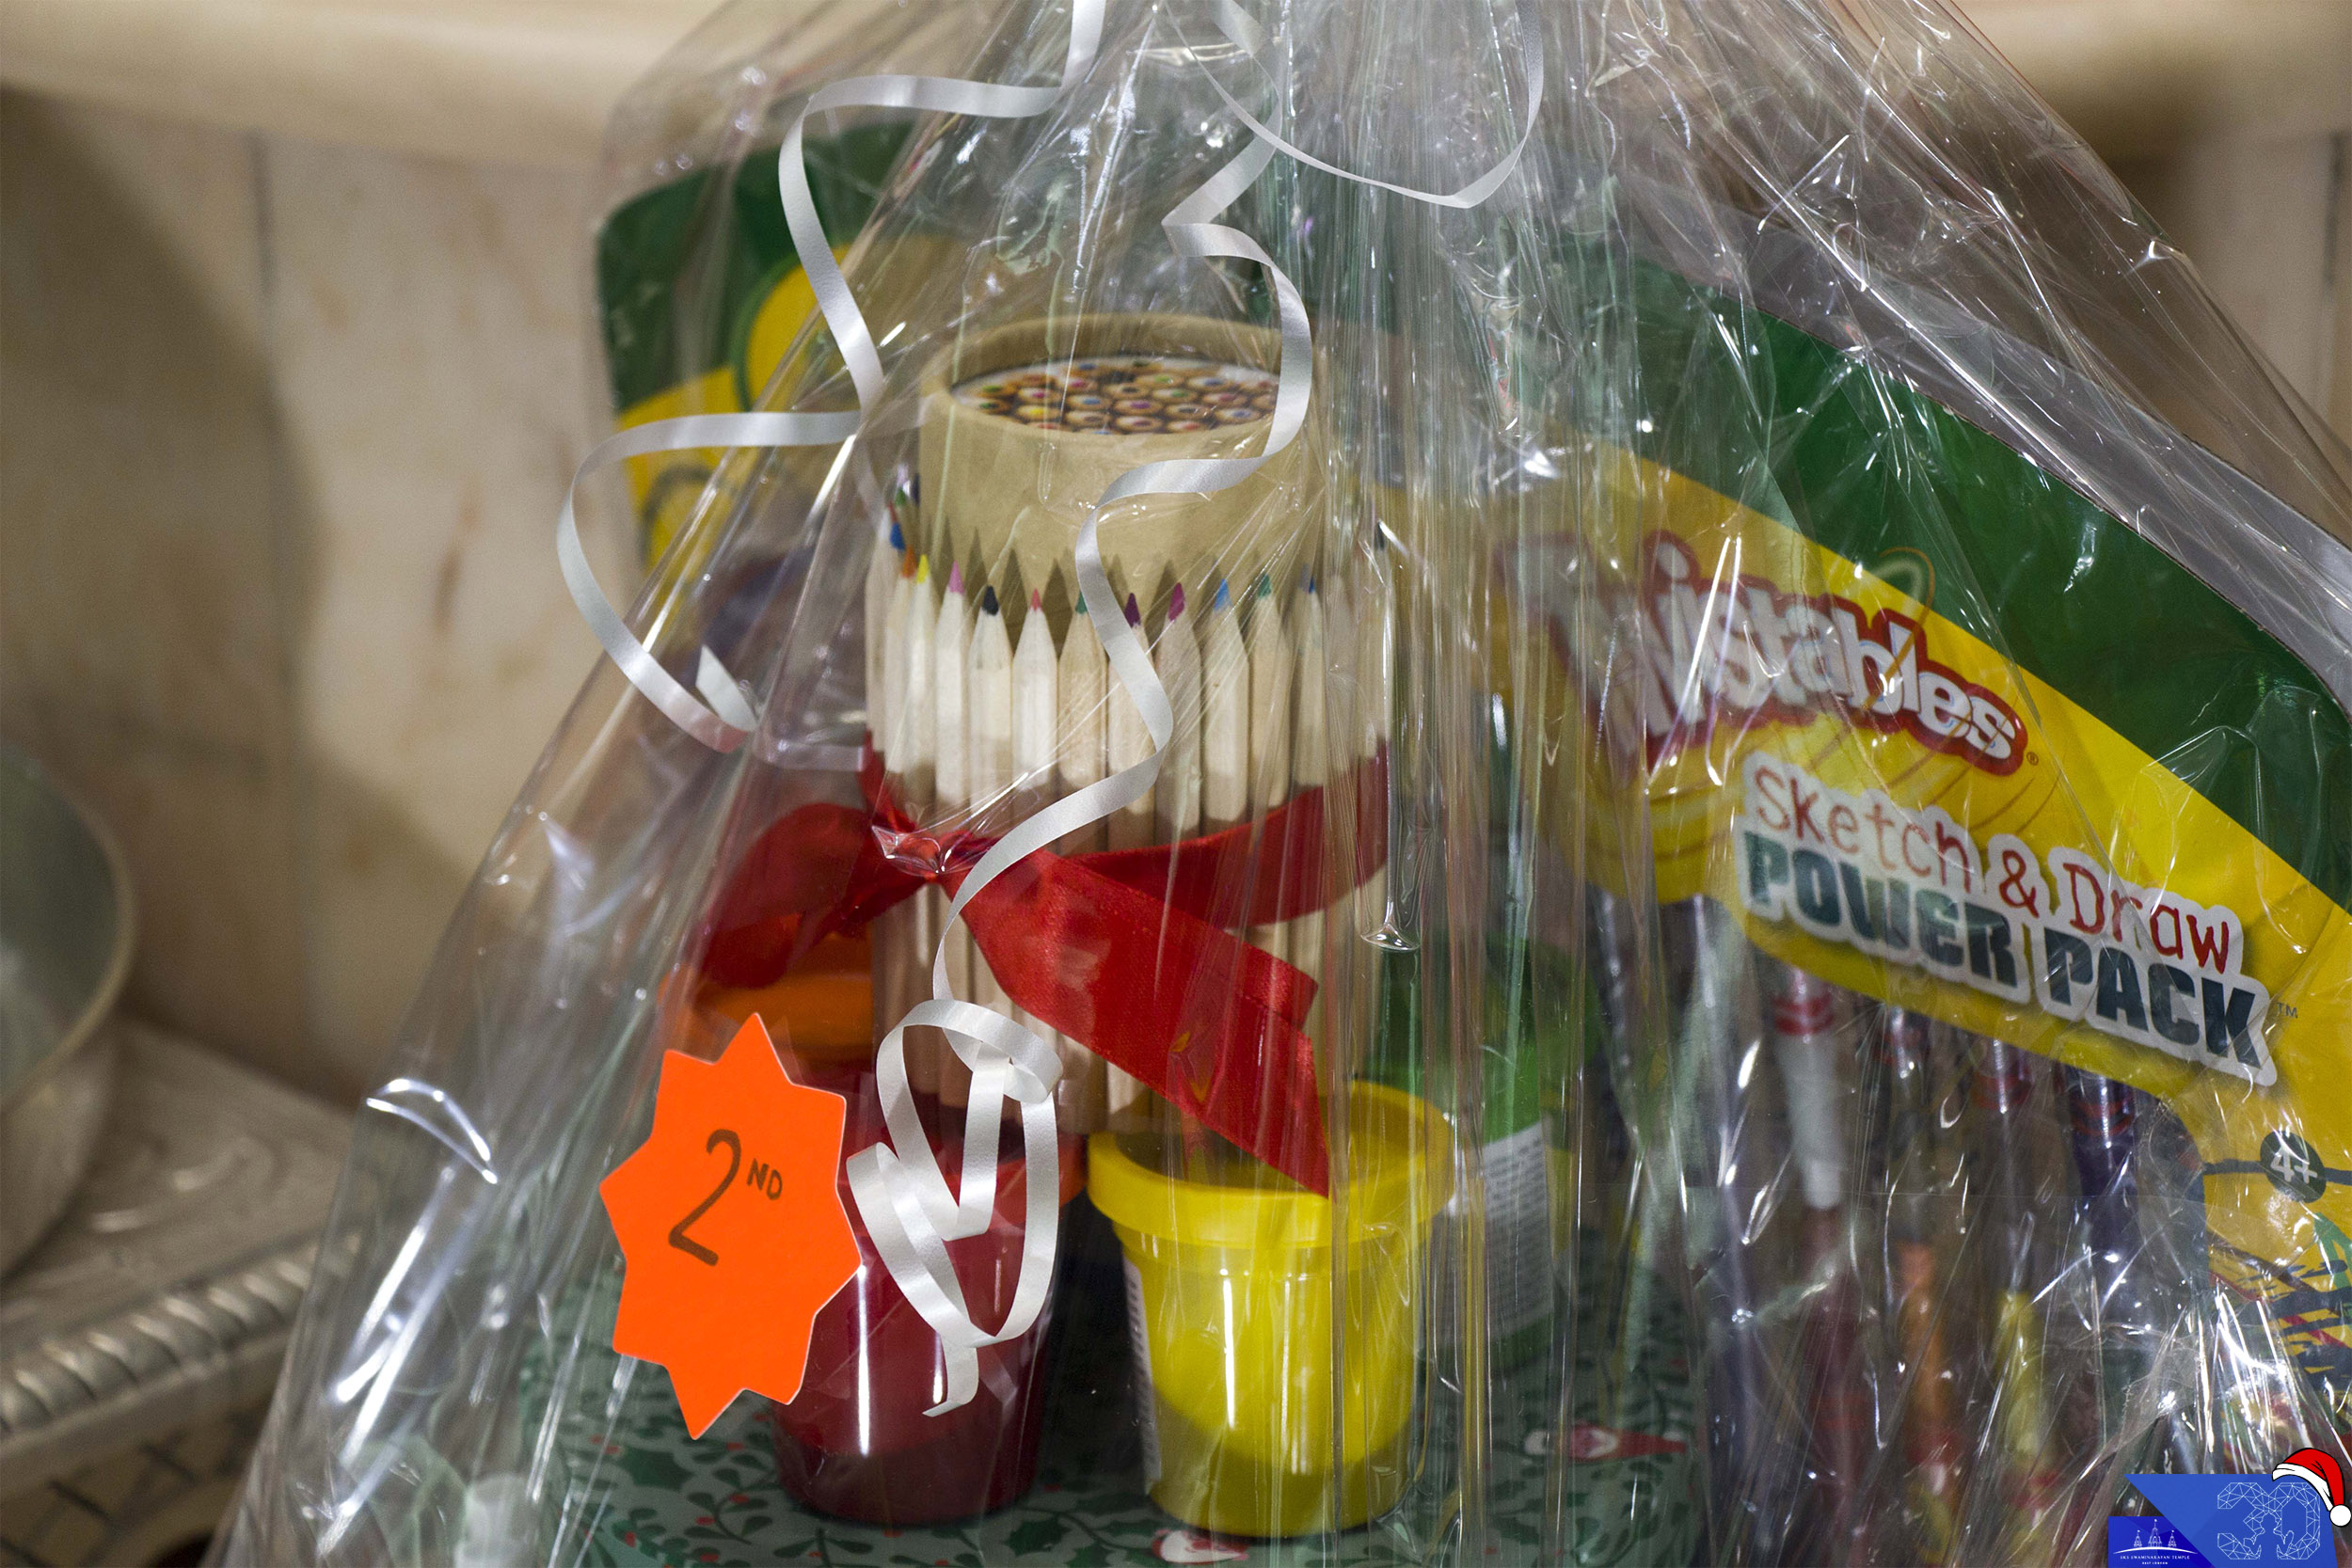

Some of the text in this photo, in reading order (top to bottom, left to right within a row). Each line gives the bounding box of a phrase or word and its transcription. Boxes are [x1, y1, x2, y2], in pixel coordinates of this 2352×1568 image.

[1743, 830, 2263, 1070] POWER PACK
[1754, 766, 2232, 975] Sketch & Draw
[2269, 1143, 2318, 1184] 4+
